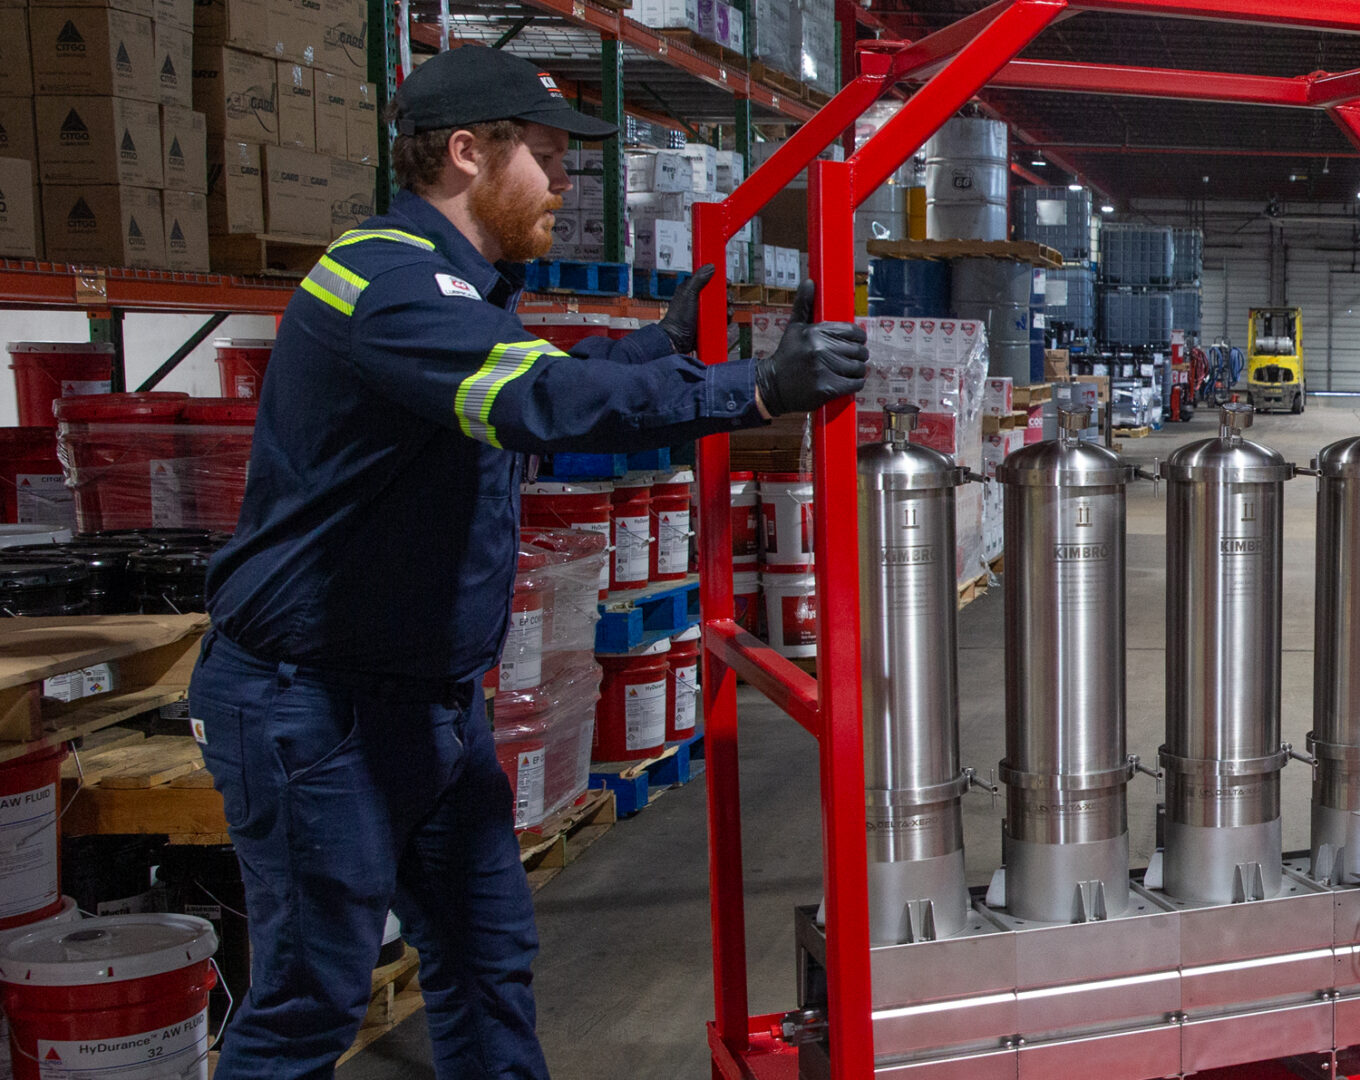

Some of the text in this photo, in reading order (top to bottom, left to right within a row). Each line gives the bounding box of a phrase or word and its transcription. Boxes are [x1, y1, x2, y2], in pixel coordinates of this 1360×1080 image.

[56, 43, 86, 51] CITGO
[60, 132, 89, 140] CITGO
[956, 177, 971, 187] 66
[1053, 546, 1108, 560] KIMBRO
[0, 789, 50, 809] AW FLUID
[162, 1026, 181, 1041] AW
[183, 1013, 204, 1032] FLUID
[147, 1046, 163, 1058] 32
